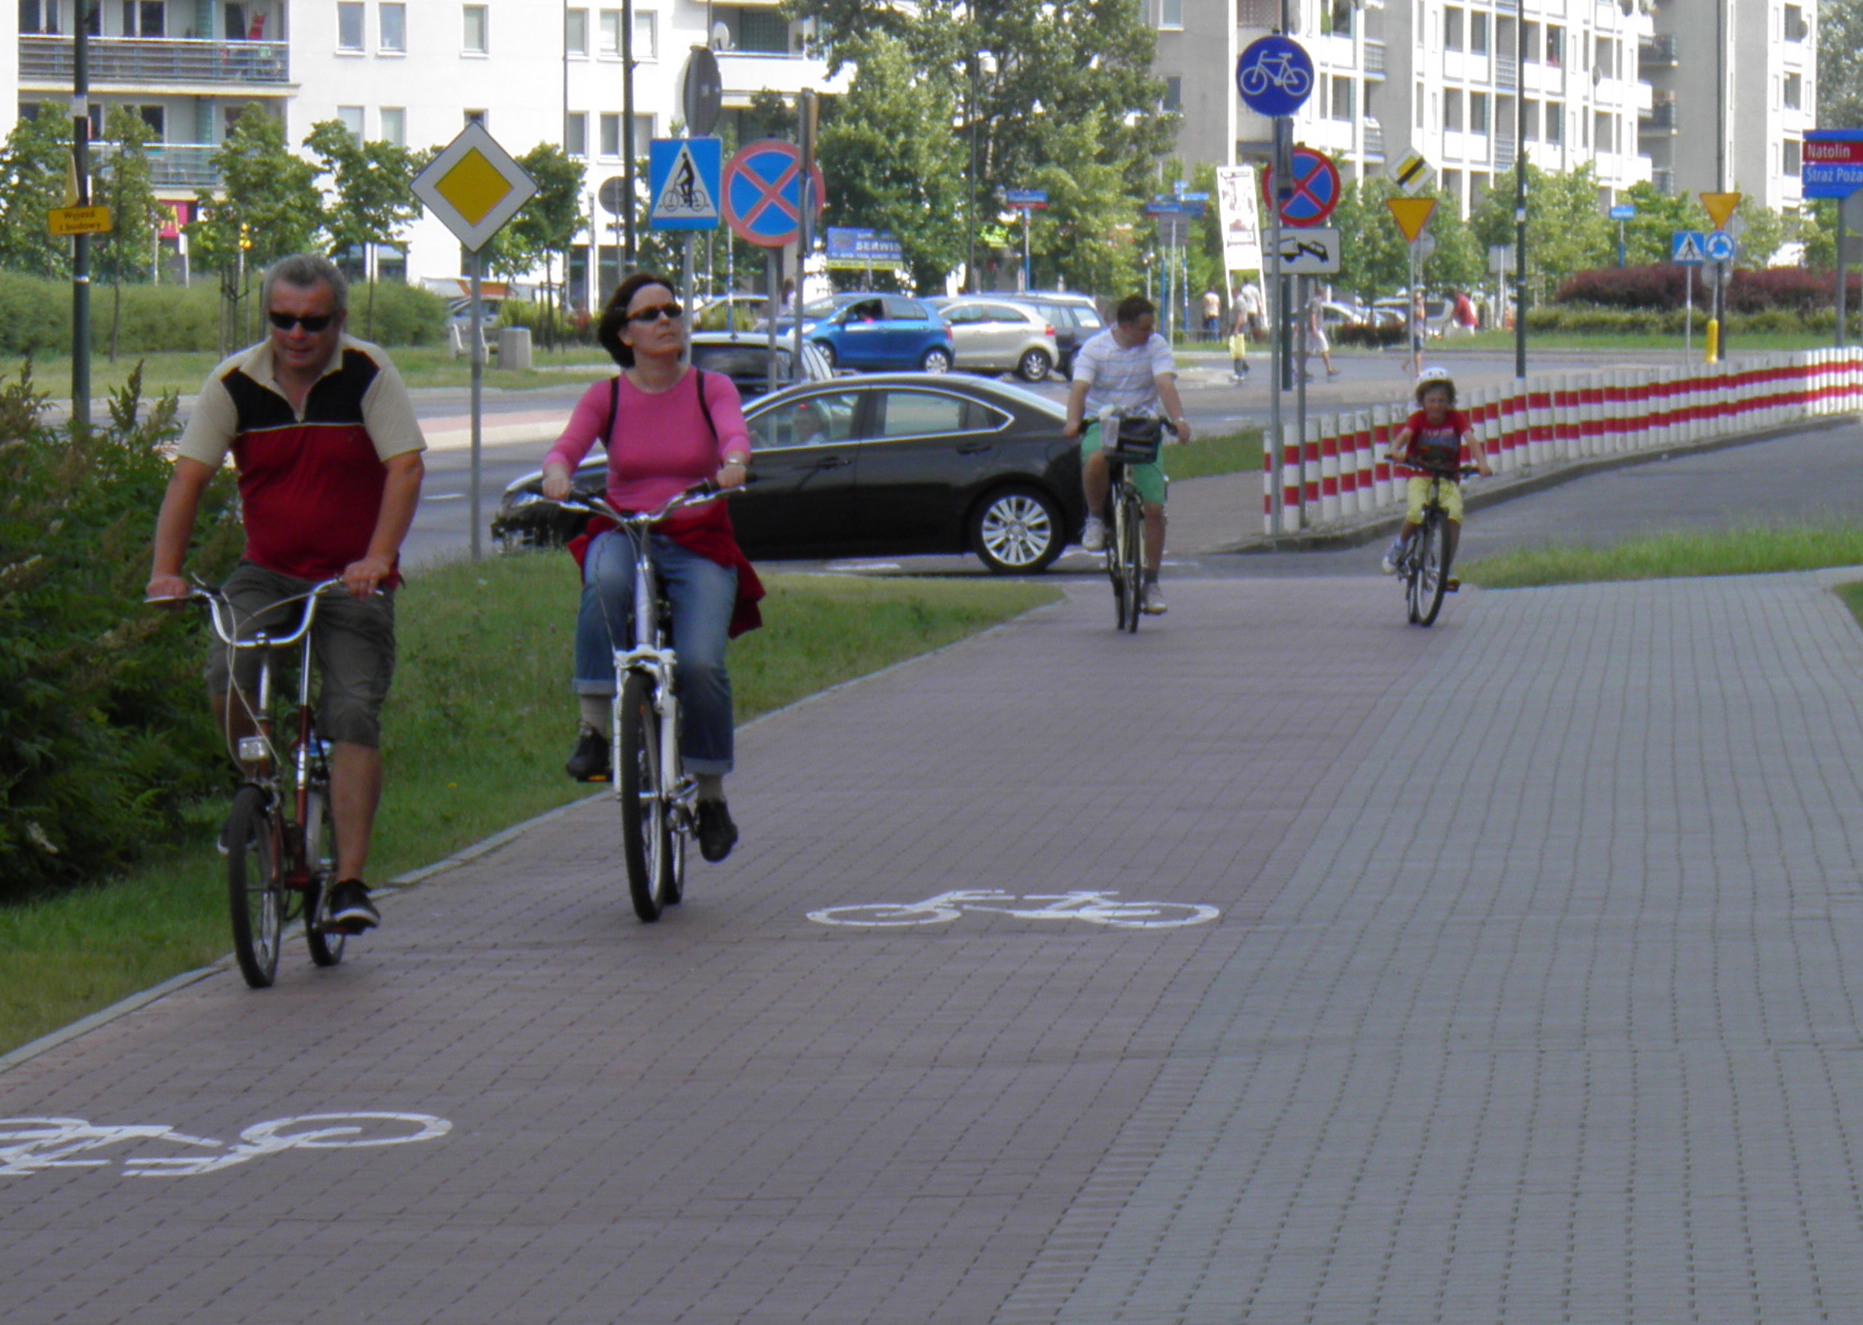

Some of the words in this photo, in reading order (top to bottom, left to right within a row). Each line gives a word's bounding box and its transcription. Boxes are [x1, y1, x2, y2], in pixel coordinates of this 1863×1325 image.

[1808, 143, 1851, 158] Natolin
[1807, 166, 1834, 182] Straż
[856, 241, 902, 251] SERWIS
